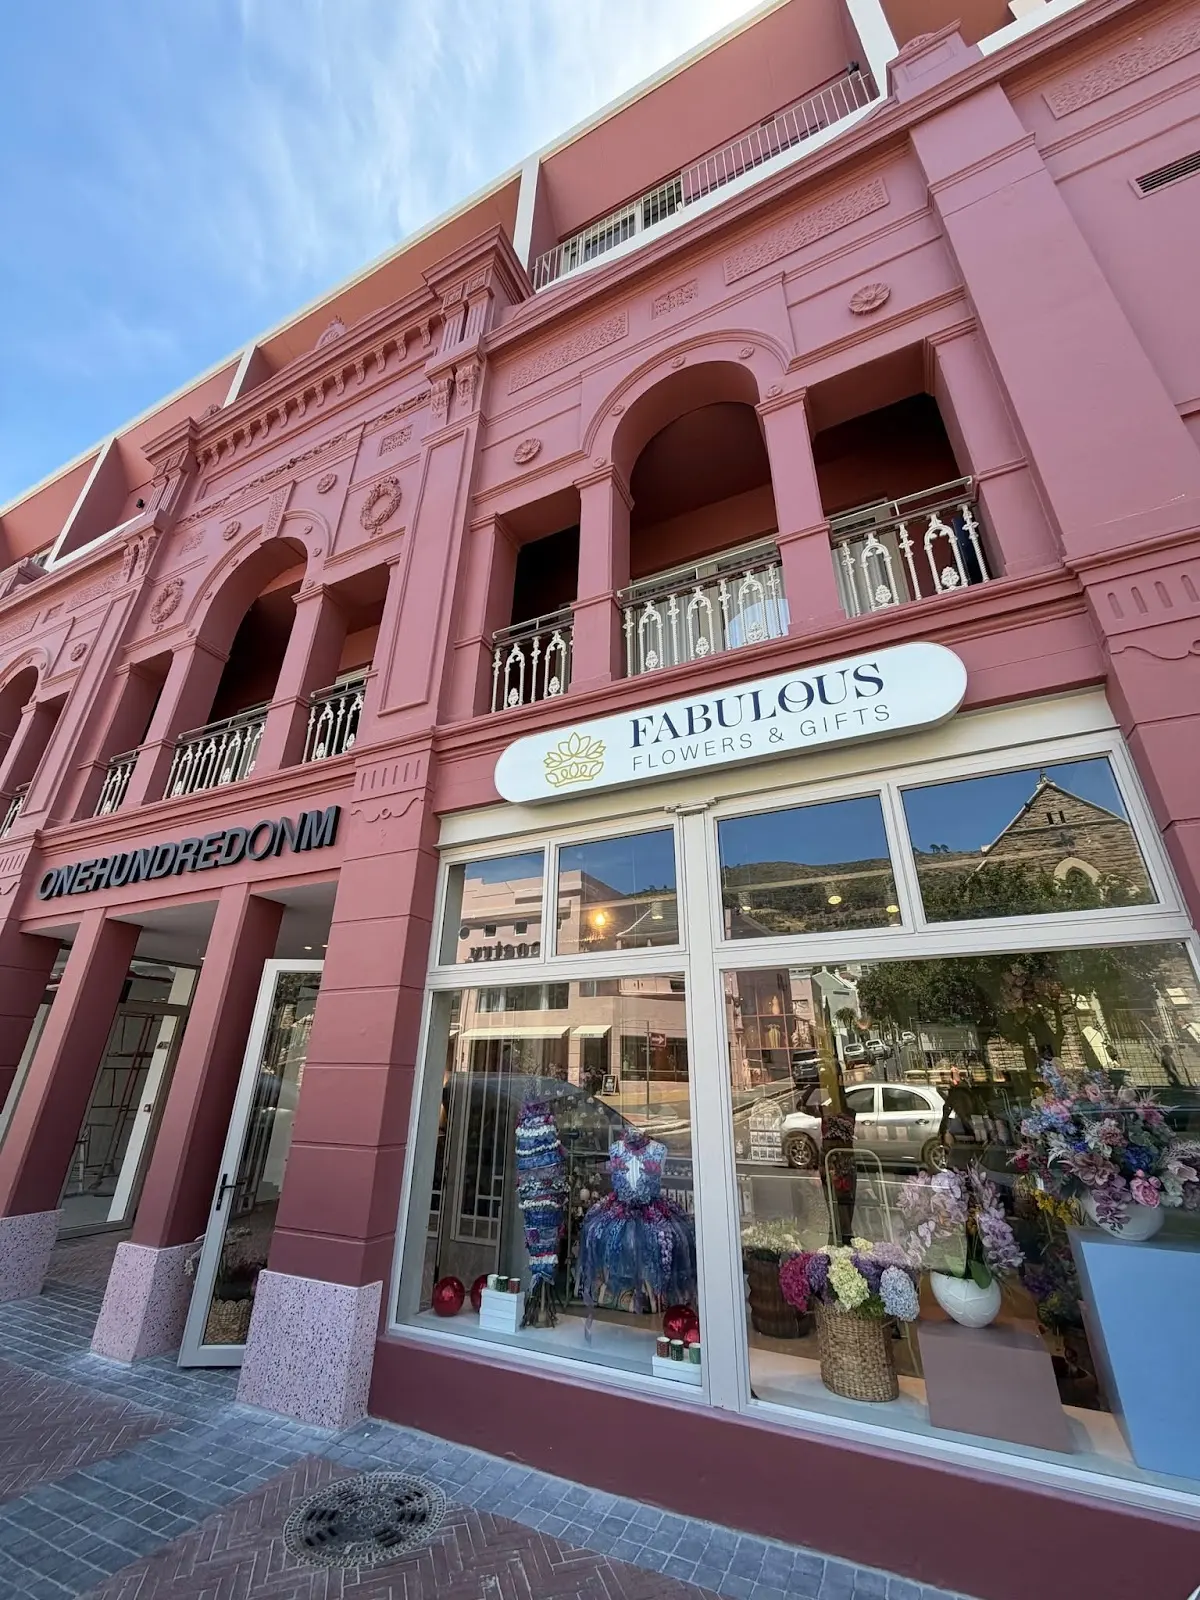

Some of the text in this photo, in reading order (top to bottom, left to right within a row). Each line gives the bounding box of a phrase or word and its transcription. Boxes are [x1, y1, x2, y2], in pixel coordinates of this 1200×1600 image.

[630, 662, 884, 748] FABULOUS
[633, 704, 890, 771] FLOWERS & GIFTS
